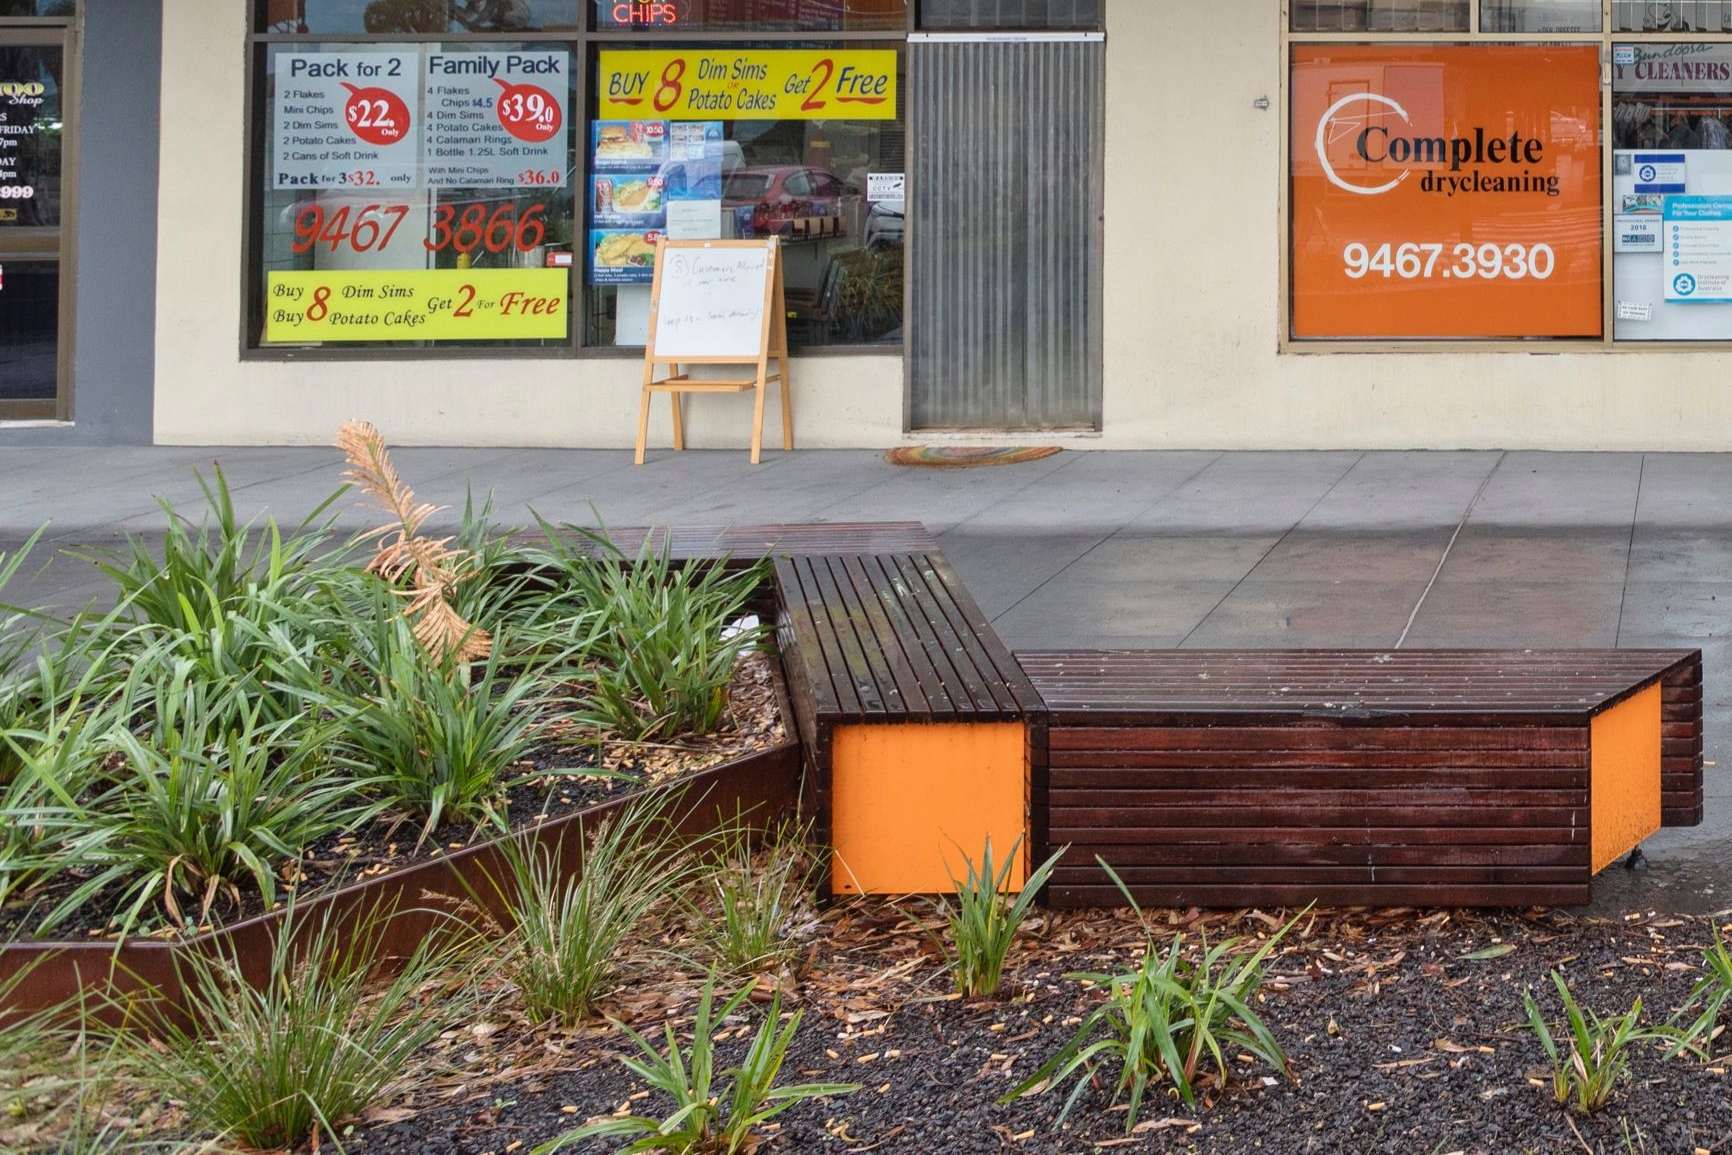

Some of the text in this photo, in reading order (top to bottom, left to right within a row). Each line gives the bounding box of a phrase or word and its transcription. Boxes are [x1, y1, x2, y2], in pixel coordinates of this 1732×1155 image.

[613, 3, 677, 23] CHIPS
[291, 58, 401, 77] Pack for 2
[429, 56, 560, 78] Family Pack
[698, 58, 768, 80] Dim Sims
[1634, 61, 1730, 81] CLEANERS
[437, 86, 470, 95] Flakes
[609, 58, 686, 112] BUY 8
[784, 59, 888, 112] Get 2 Free
[8, 93, 44, 107] Shop
[293, 90, 325, 99] Flakes
[687, 88, 776, 110] Potato Cakes
[284, 105, 334, 116] Mini Chips
[441, 98, 470, 108] Chips
[437, 111, 484, 120] Dim Sims
[293, 121, 338, 130] Dim Sims
[381, 128, 400, 137] Only
[436, 123, 503, 132] Potato Cakes
[536, 122, 554, 132] Only
[293, 136, 356, 145] Potato Cakes
[436, 135, 512, 146] Calamari Rings
[292, 151, 378, 160] Cans of Soft Drink
[436, 147, 548, 156] Bottle 1.25L Soft Drink
[1357, 126, 1543, 171] Complete
[466, 166, 489, 175] Chips
[279, 172, 319, 185] Pack
[322, 175, 336, 183] for
[391, 173, 412, 184] only
[1420, 170, 1560, 197] drycleaning
[291, 203, 545, 253] 9467 3866
[1343, 243, 1555, 279] 9467.3930
[273, 283, 304, 301] Buy
[341, 285, 414, 298] Dim Sims
[307, 286, 331, 321] 8
[427, 297, 453, 311] Get
[453, 284, 476, 317] 2
[500, 292, 561, 315] Free
[273, 310, 304, 326] Buy
[329, 310, 426, 326] Potato Cakes
